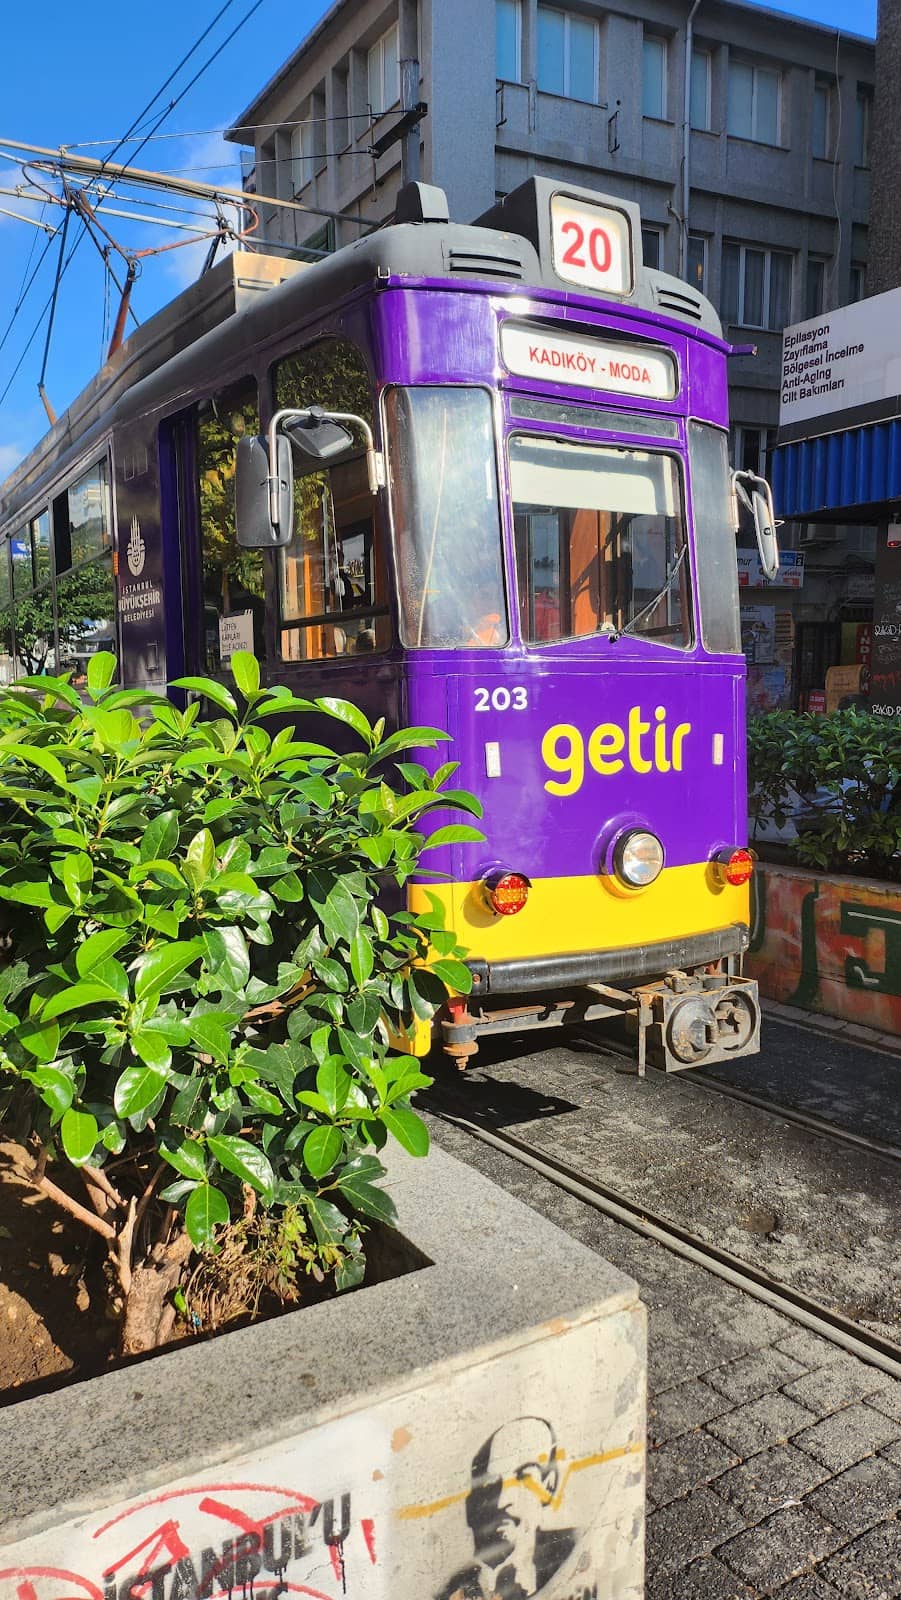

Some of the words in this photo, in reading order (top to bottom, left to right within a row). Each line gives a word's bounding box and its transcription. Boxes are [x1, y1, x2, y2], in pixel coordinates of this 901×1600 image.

[561, 221, 612, 273] 20
[784, 325, 830, 348] Epilasyon
[529, 346, 596, 373] KADIKÖY
[609, 361, 651, 384] MODA
[783, 355, 823, 377] Bölgesel
[782, 368, 832, 391] Anti-Aging
[782, 390, 797, 404] Cilt
[799, 379, 845, 400] Bakımları
[474, 686, 528, 711] 203
[541, 705, 691, 797] getir
